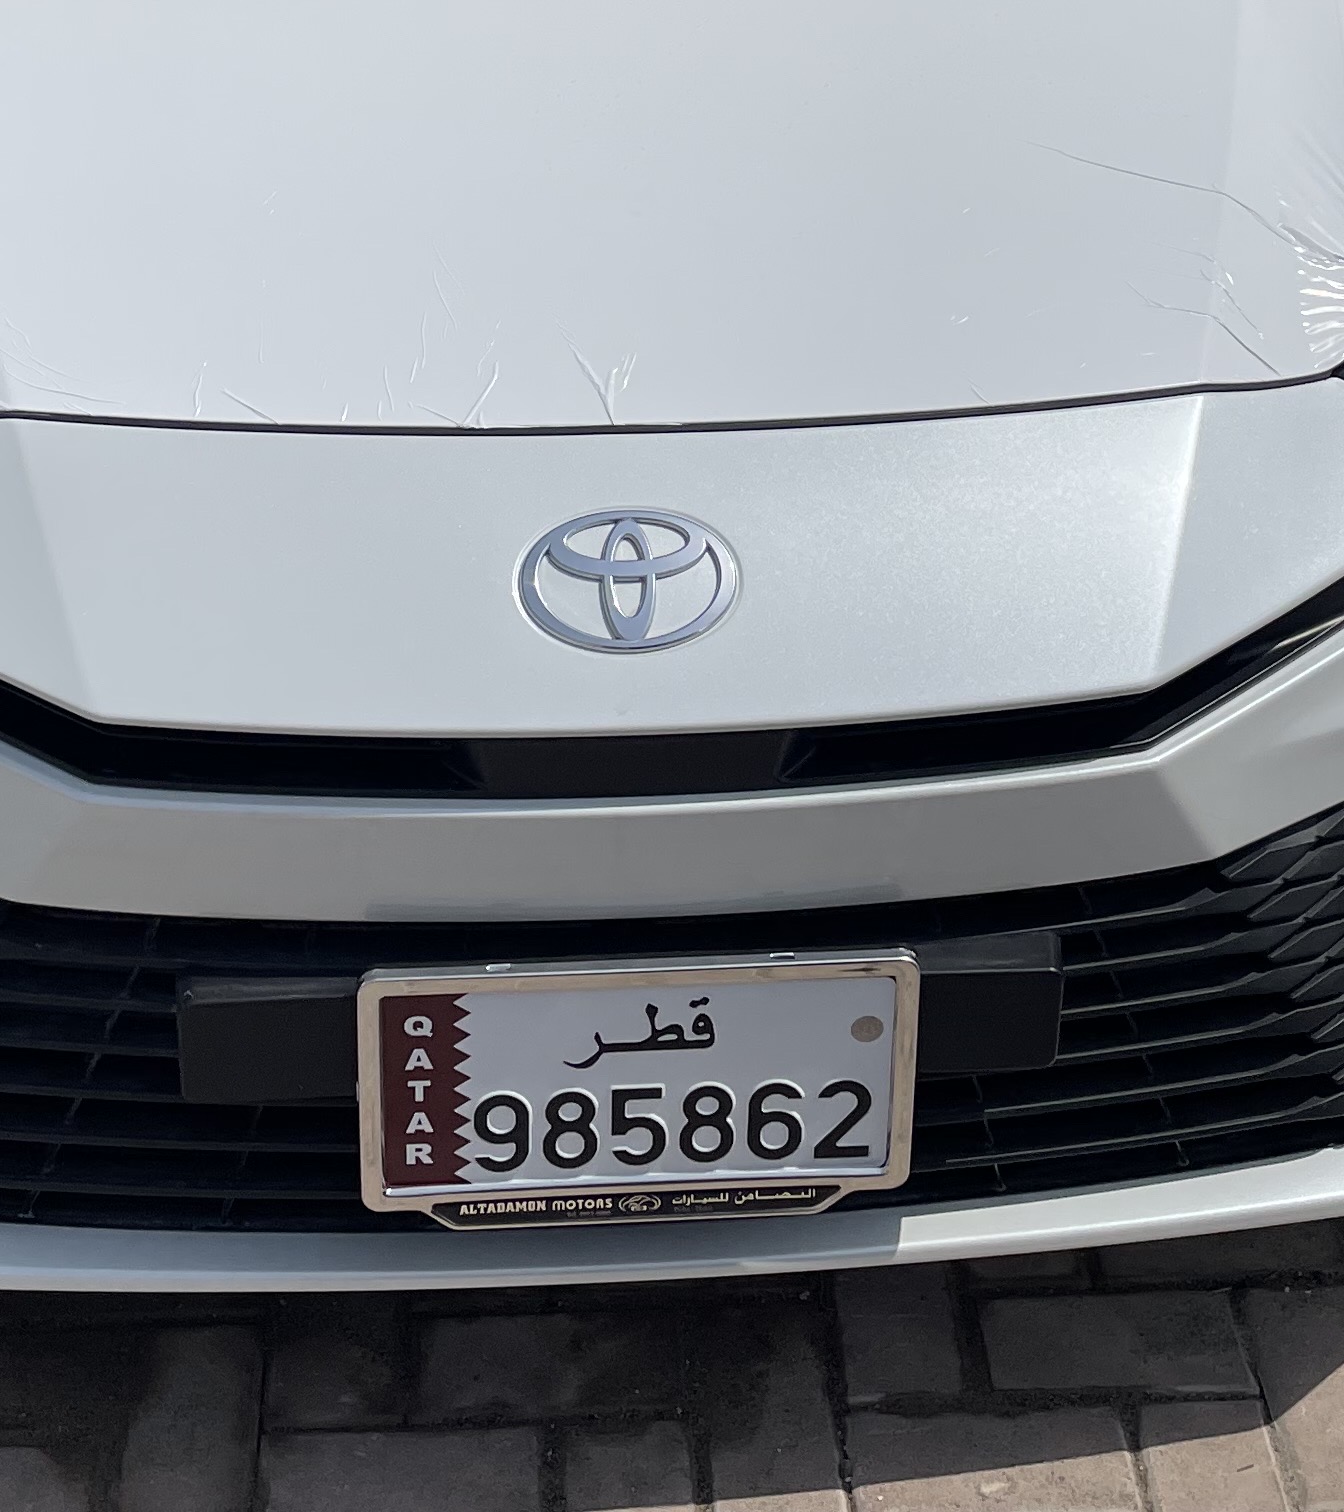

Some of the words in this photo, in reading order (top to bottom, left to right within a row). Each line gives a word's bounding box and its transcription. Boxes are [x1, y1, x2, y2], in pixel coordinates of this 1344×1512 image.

[563, 996, 716, 1070] قطر
[403, 1015, 434, 1166] QATAR
[473, 1078, 873, 1174] 985862
[459, 1199, 547, 1216] ALTADAMON
[552, 1197, 613, 1212] MOTORS
